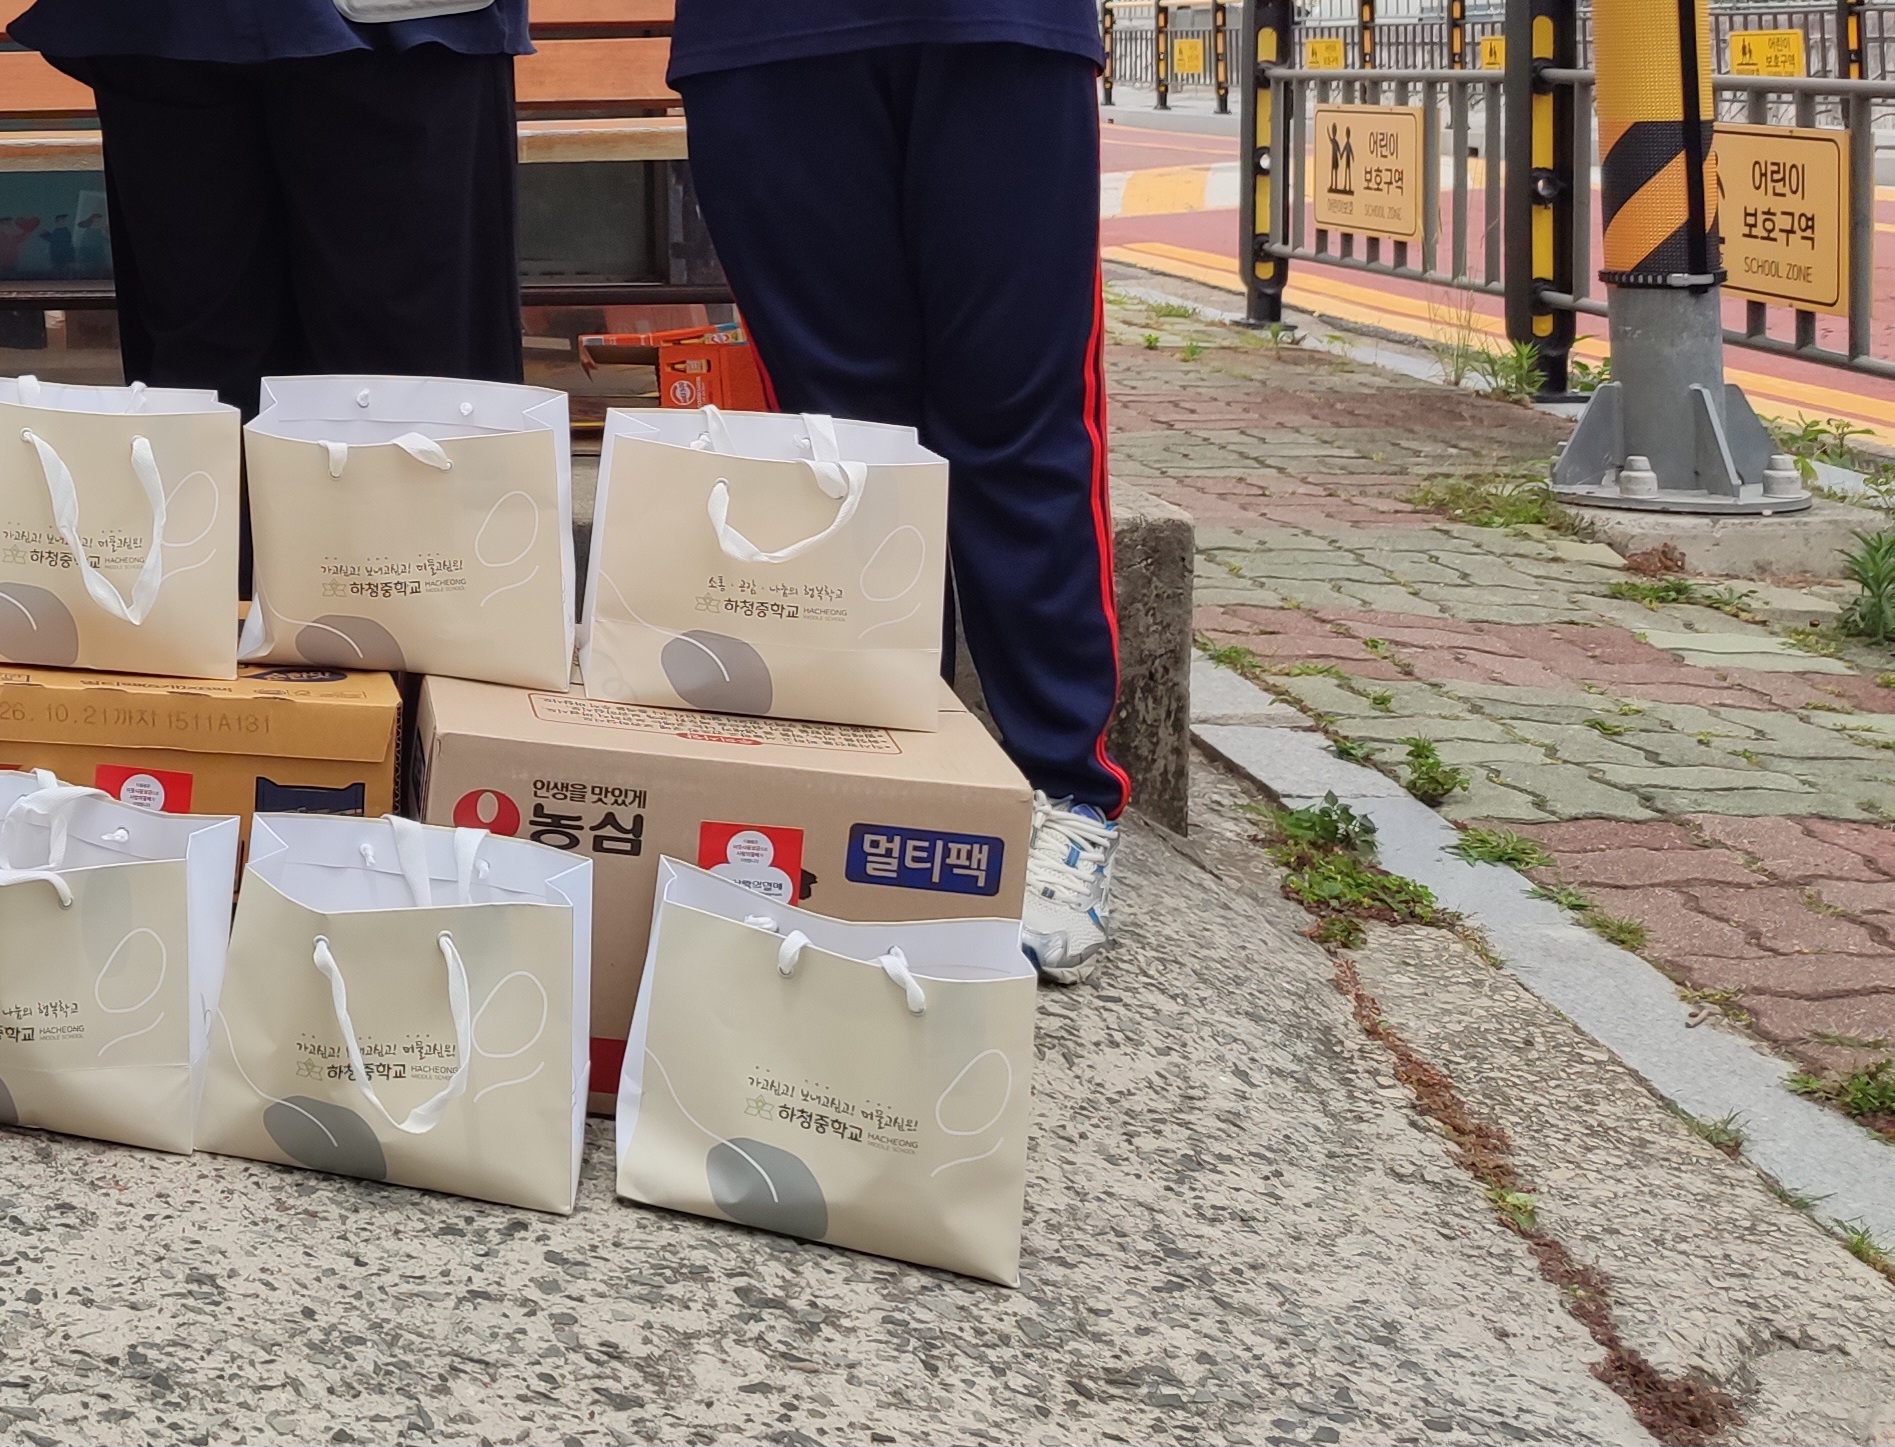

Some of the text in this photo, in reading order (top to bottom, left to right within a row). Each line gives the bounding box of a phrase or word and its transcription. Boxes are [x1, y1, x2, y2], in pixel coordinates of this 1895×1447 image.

[1768, 36, 1791, 52] 어린이
[1765, 53, 1796, 69] 보호구역
[1369, 131, 1399, 160] 어린이
[1363, 166, 1404, 196] 보호구역
[1752, 159, 1806, 201] 어린이
[1364, 204, 1385, 219] SCHOOL
[1742, 206, 1815, 250] 보호구역
[1744, 256, 1813, 284] SCHOOL ZONE
[30, 548, 145, 569] 하청중교 HACHEONG
[350, 578, 467, 598] 하청중학교 HACHEONG
[708, 575, 843, 602] 소통 공감 나눔의 행복학교
[724, 597, 848, 619] 하청중학교 HACHEONG
[532, 778, 647, 810] 인생을 맛있게
[528, 802, 644, 857] 농심
[861, 832, 990, 888] 멀티팩
[3, 1004, 33, 1020] 나눔의
[38, 999, 78, 1019] 행복학교
[39, 1025, 84, 1034] HACHEONG
[410, 1065, 458, 1074] HACHEONG
[778, 1103, 919, 1149] 하청중학교 HACHEONG
